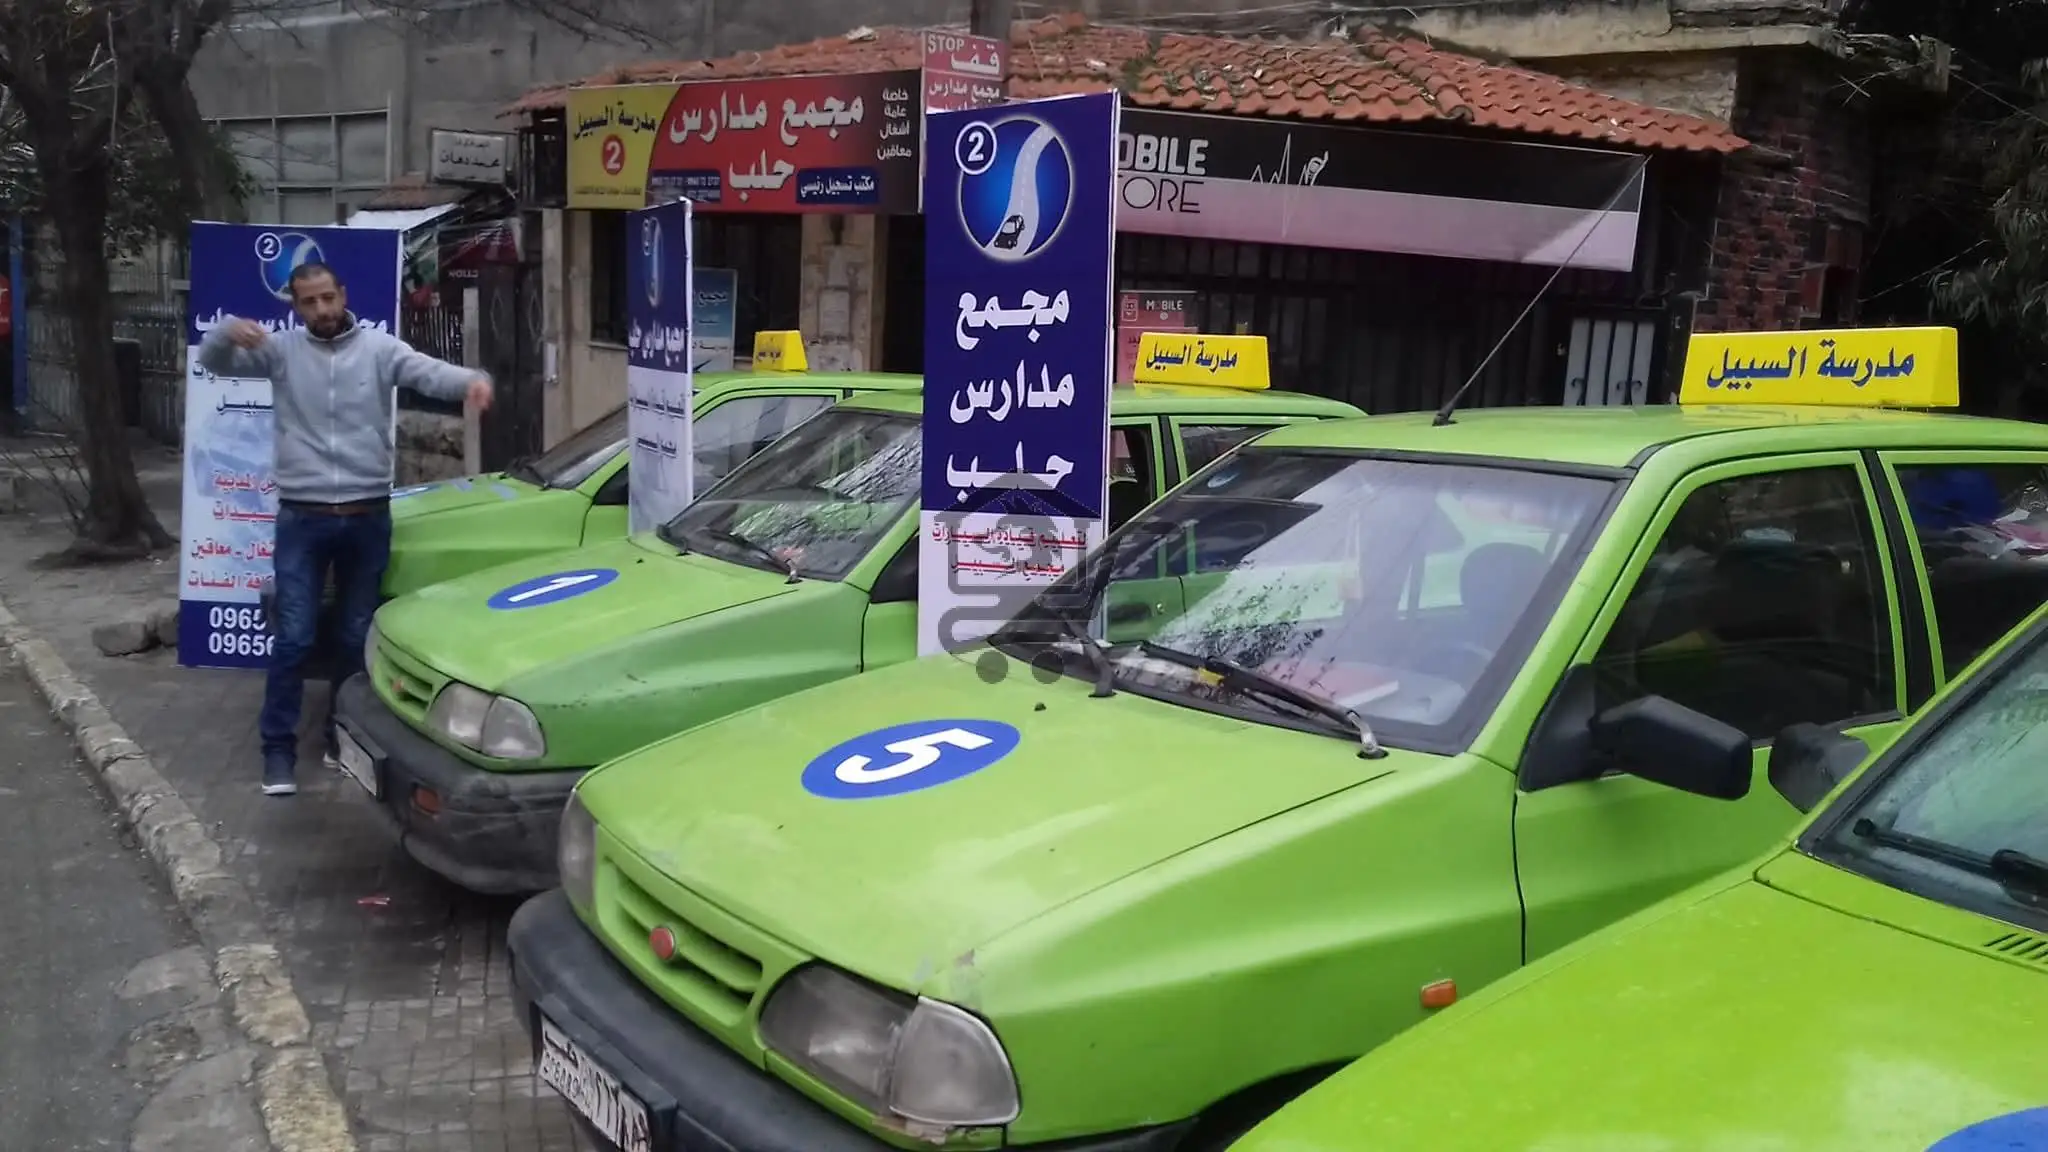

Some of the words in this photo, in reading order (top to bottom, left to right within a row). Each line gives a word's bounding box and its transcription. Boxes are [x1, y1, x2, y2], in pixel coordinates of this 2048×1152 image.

[928, 34, 964, 54] STOP
[951, 43, 1000, 75] قف
[929, 79, 968, 96] مدارس
[970, 84, 1000, 103] مجمع
[574, 104, 614, 141] السبيل
[618, 100, 656, 134] مدرسة
[670, 90, 768, 144] مدارس
[780, 95, 865, 146] مجمع
[606, 140, 621, 169] 2
[967, 130, 985, 162] 2
[729, 149, 795, 203] حلب
[826, 174, 853, 196] تسجيل
[853, 175, 875, 196] مكتب
[262, 238, 274, 255] 2
[955, 289, 1070, 351] مجمع
[1145, 342, 1192, 371] السبيل
[1195, 339, 1239, 374] مدرسة
[1705, 345, 1808, 391] السبيل
[1816, 338, 1915, 387] مدرسة
[949, 358, 1076, 424] مدارس
[945, 440, 1076, 504] حلب
[507, 574, 600, 603] 1
[834, 727, 994, 784] 5
